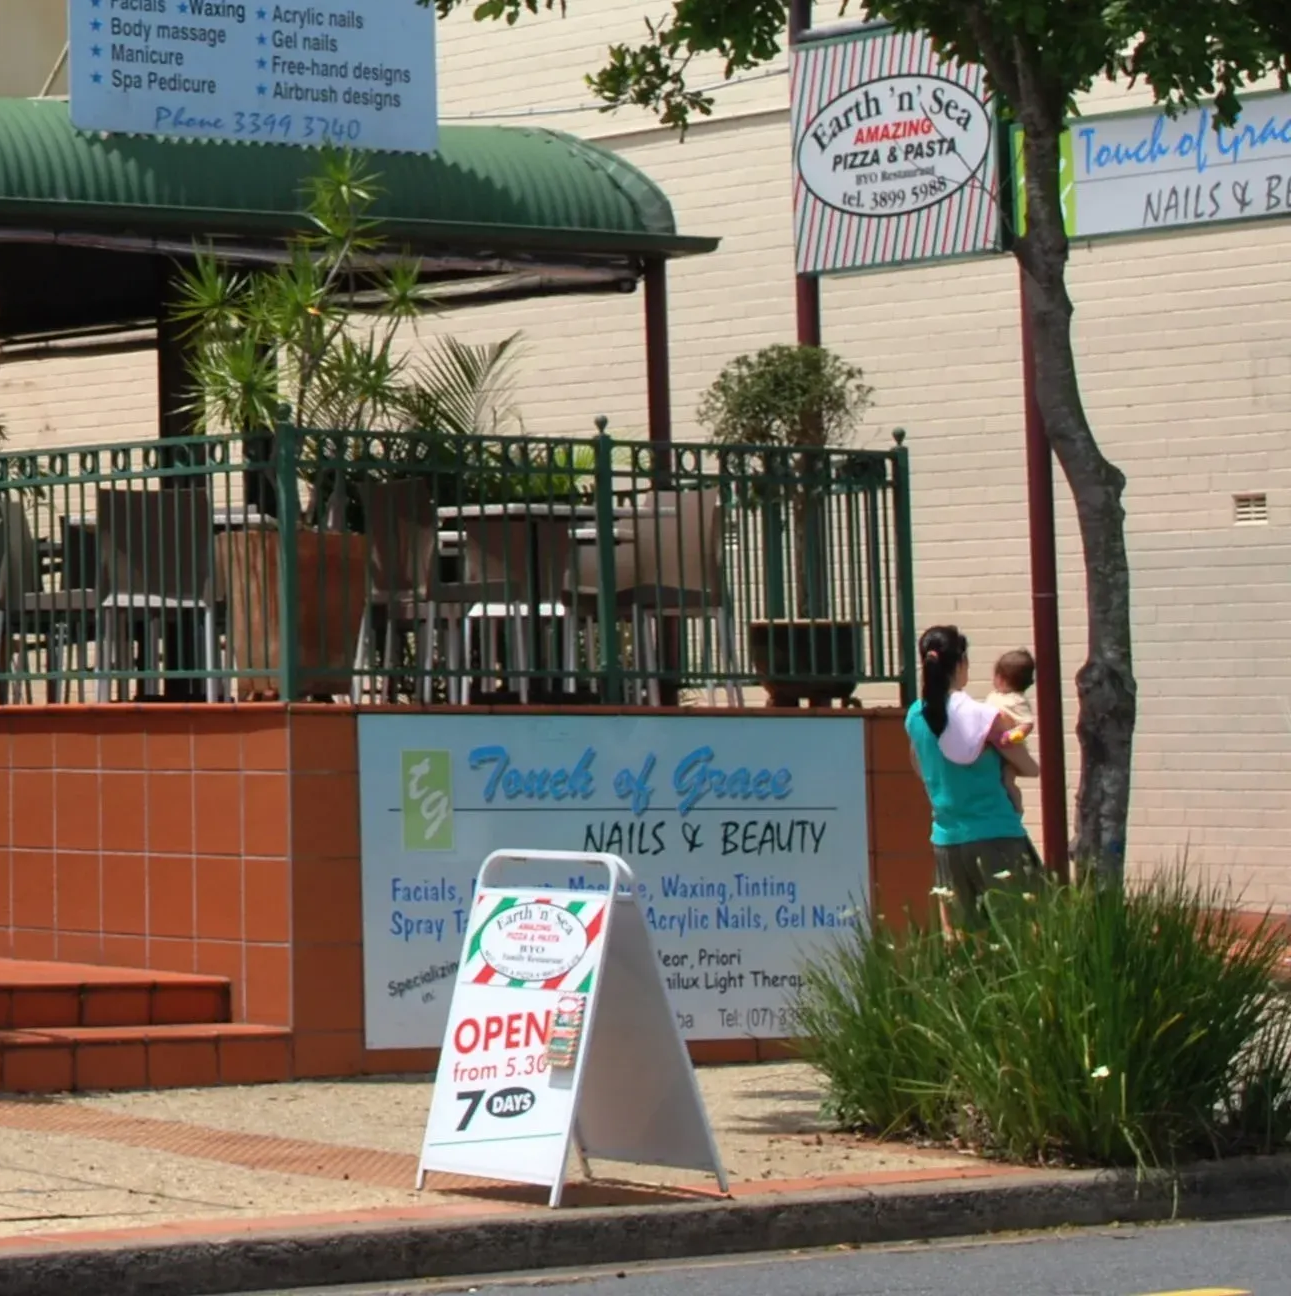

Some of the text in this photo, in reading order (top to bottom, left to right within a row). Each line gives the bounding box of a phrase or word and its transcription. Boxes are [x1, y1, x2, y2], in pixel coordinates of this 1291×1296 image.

[111, 18, 226, 46] Body massage
[272, 5, 364, 30] Acrylic nails
[111, 44, 184, 66] Manicure
[272, 31, 338, 53] Gel nails
[112, 71, 216, 95] Spa Pedicure
[272, 55, 411, 87] Free-hand designs
[273, 81, 402, 112] Airbrush designs
[154, 106, 361, 141] Phone 3399 3740
[810, 89, 882, 153] Earth
[929, 87, 972, 132] Sea
[854, 118, 934, 145] AMAZING
[832, 137, 957, 172] PIZZA & PASTA
[1078, 114, 1169, 175] Touch
[1175, 107, 1209, 173] of
[855, 165, 935, 186] BYO Restaurant
[842, 176, 948, 210] tel. 3899 5988
[1143, 181, 1221, 225] NAILS
[1232, 180, 1253, 214] &
[469, 745, 795, 815] Touch of Grace
[583, 821, 827, 855] NAILS & BEAUTY
[391, 878, 463, 904] Facials,
[733, 873, 796, 904] Tinting
[390, 910, 444, 942] Spray
[497, 906, 533, 931] Earth
[556, 912, 575, 936] Sea
[646, 905, 709, 937] Acrylic
[716, 906, 768, 932] Nails,
[775, 904, 805, 928] Gel
[519, 944, 546, 955] BYO
[658, 948, 742, 970] eor, Priori
[387, 960, 460, 997] Specializin
[704, 971, 744, 994] Light
[751, 971, 809, 994] Therap
[453, 1010, 552, 1055] OPEN
[718, 1008, 743, 1029] Tel:
[746, 1007, 774, 1031] (07)
[453, 1060, 497, 1083] from
[455, 1090, 533, 1132] 7 DAYS
